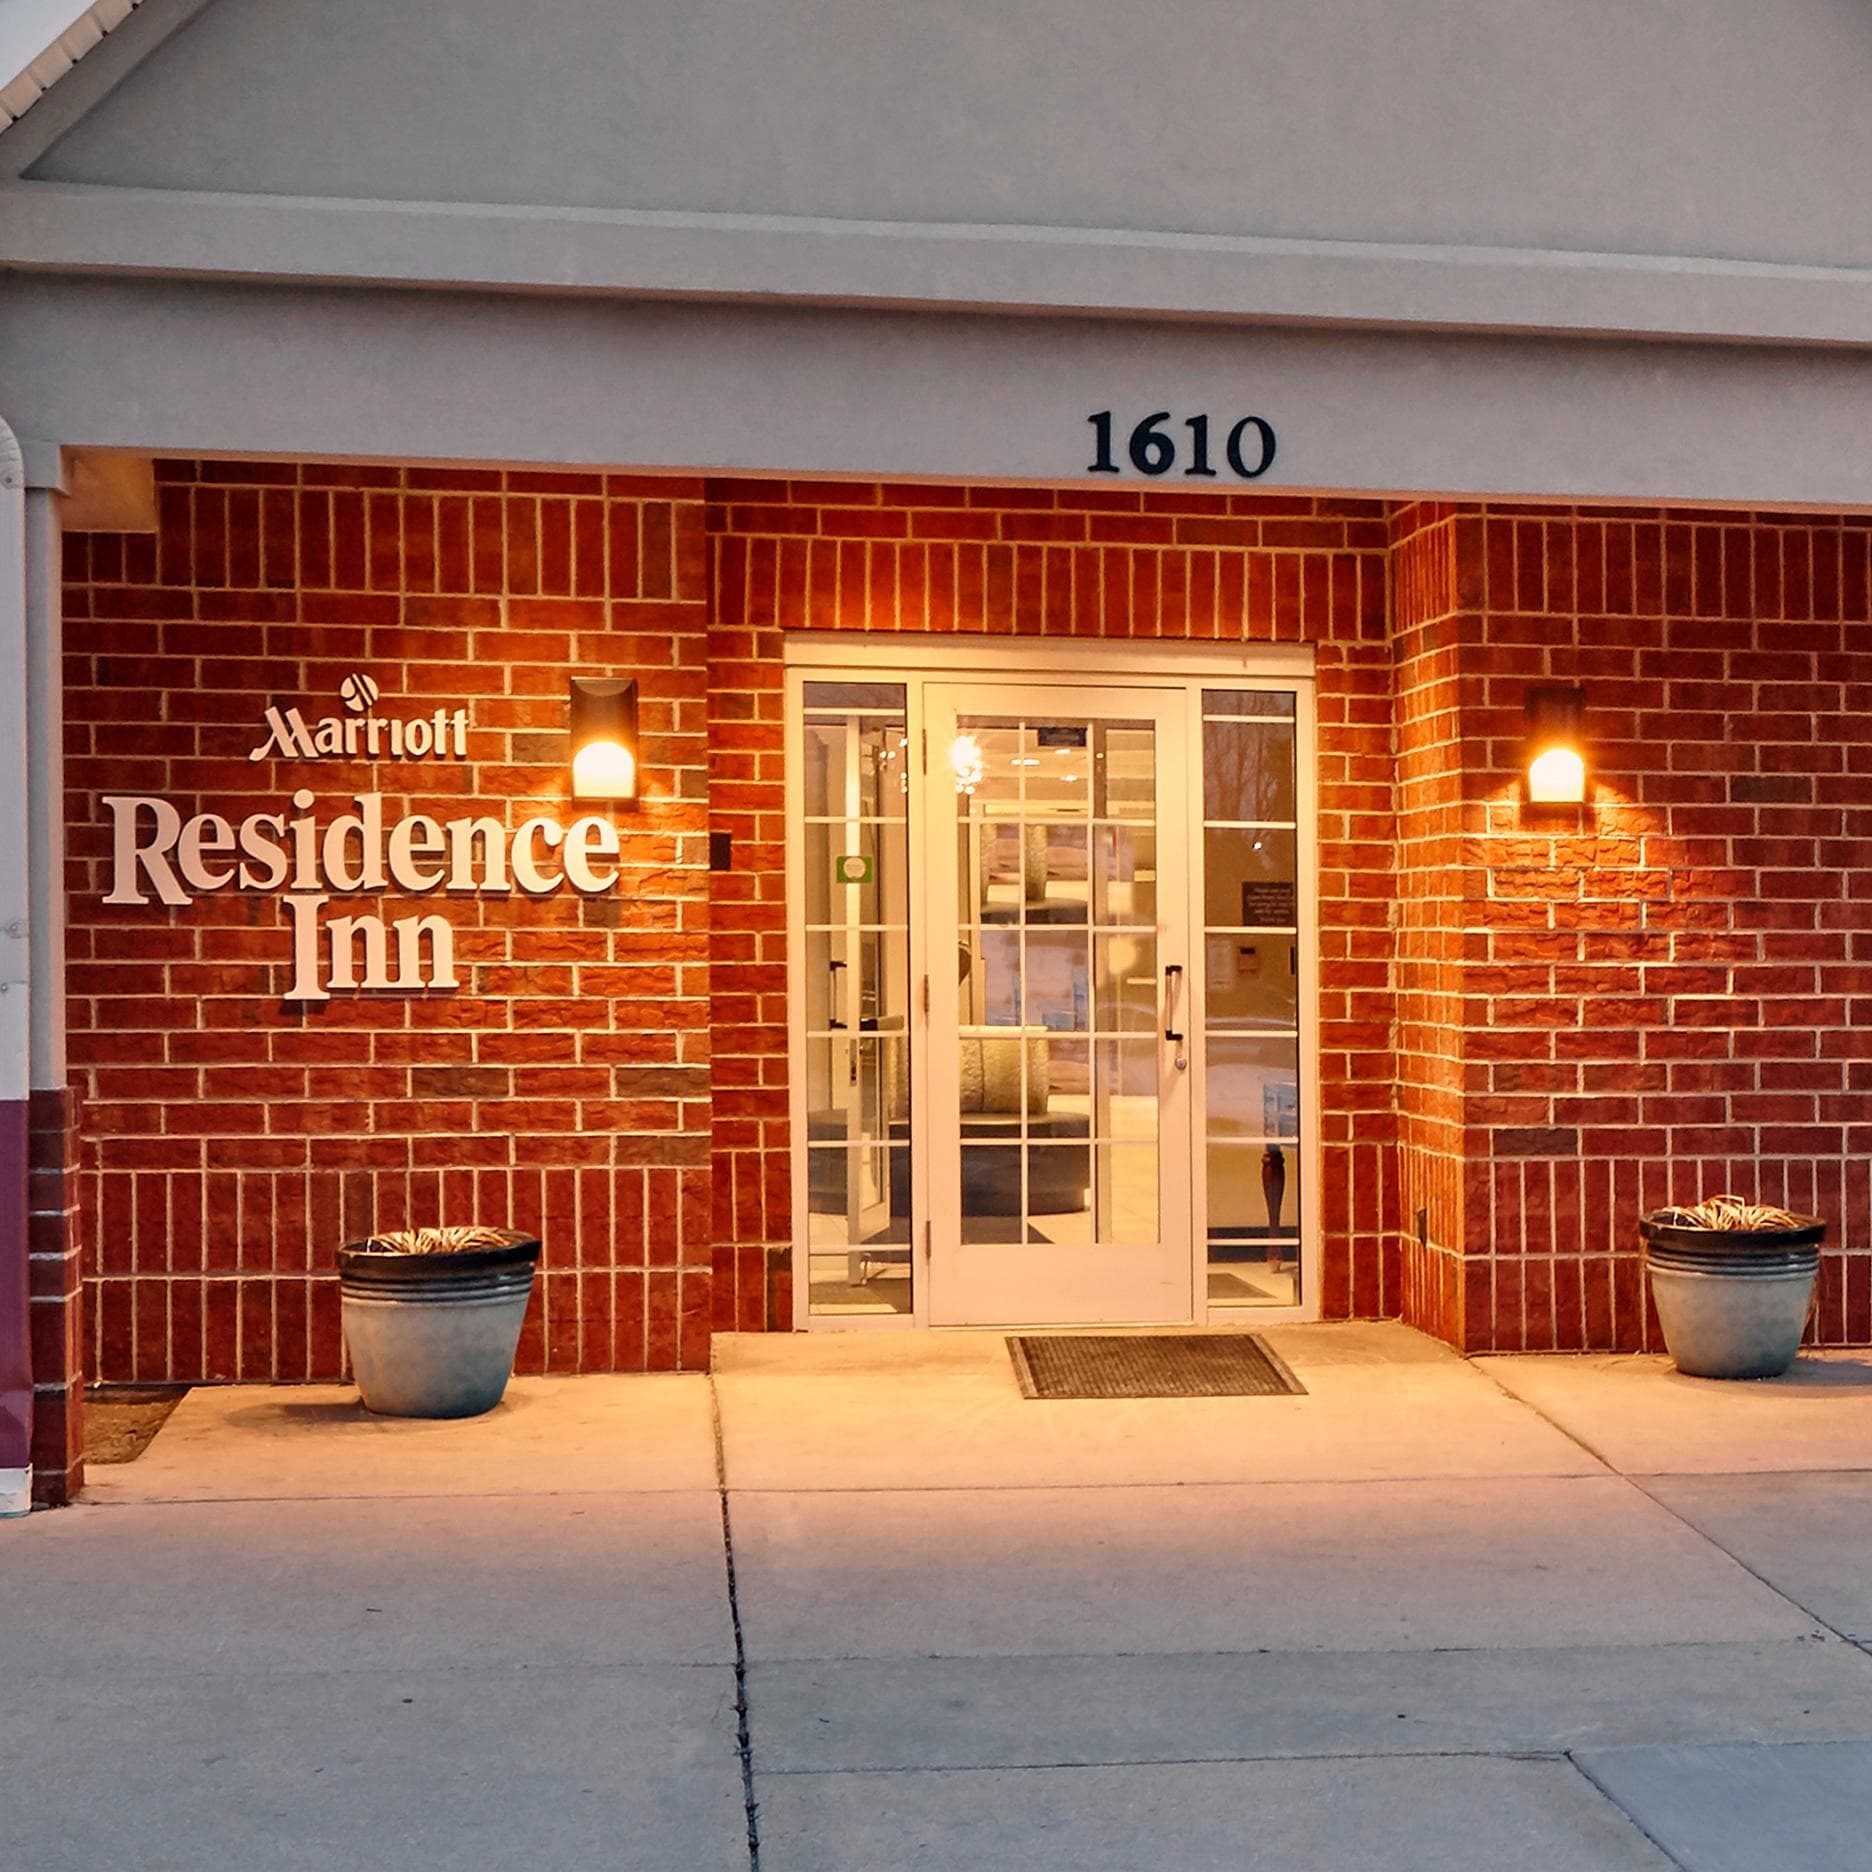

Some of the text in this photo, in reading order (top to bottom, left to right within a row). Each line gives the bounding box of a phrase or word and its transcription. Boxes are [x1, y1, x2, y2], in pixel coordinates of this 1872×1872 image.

[1087, 410, 1276, 478] 1610
[249, 705, 469, 762] Marriott
[102, 788, 620, 906] Residence
[282, 894, 460, 1000] Inn
